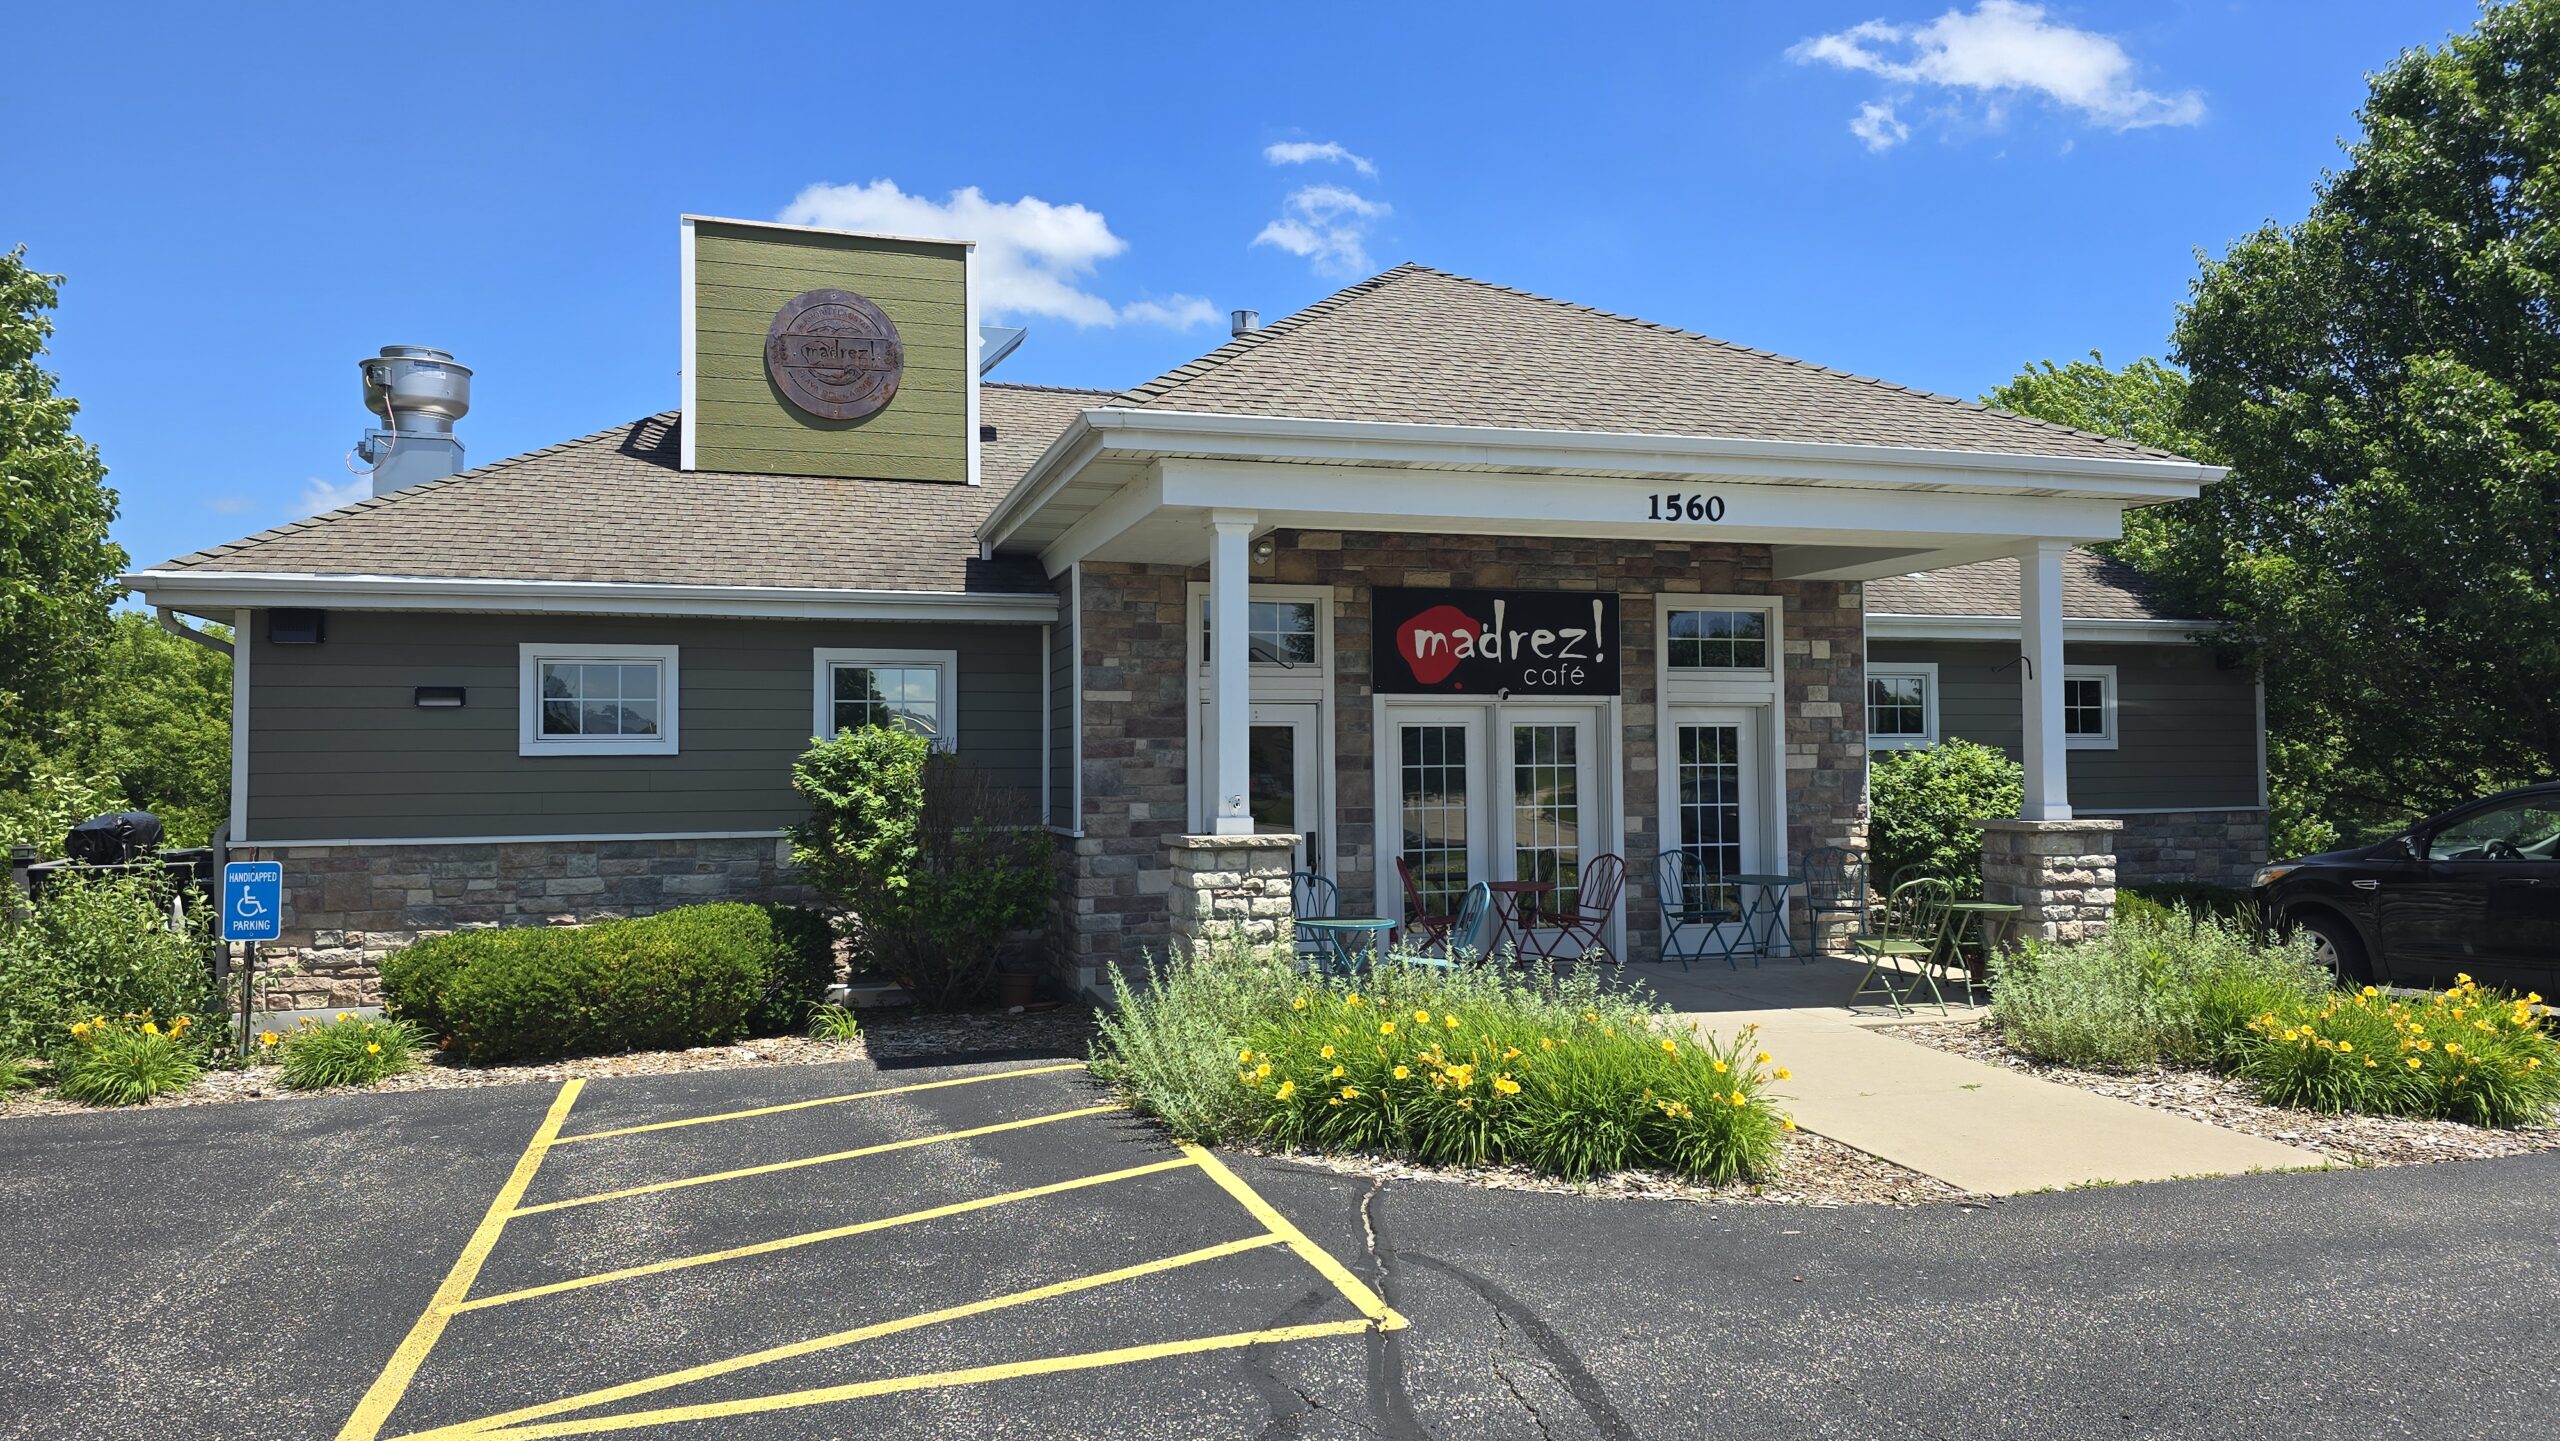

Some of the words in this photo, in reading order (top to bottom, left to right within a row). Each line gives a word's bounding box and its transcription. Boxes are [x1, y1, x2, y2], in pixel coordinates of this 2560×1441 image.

[805, 338, 876, 361] madrez!
[1647, 493, 1726, 522] 1560
[1413, 599, 1604, 663] madrez!
[1523, 663, 1585, 686] café
[229, 872, 277, 882] HANDICAPPED
[233, 920, 270, 931] PARKING
